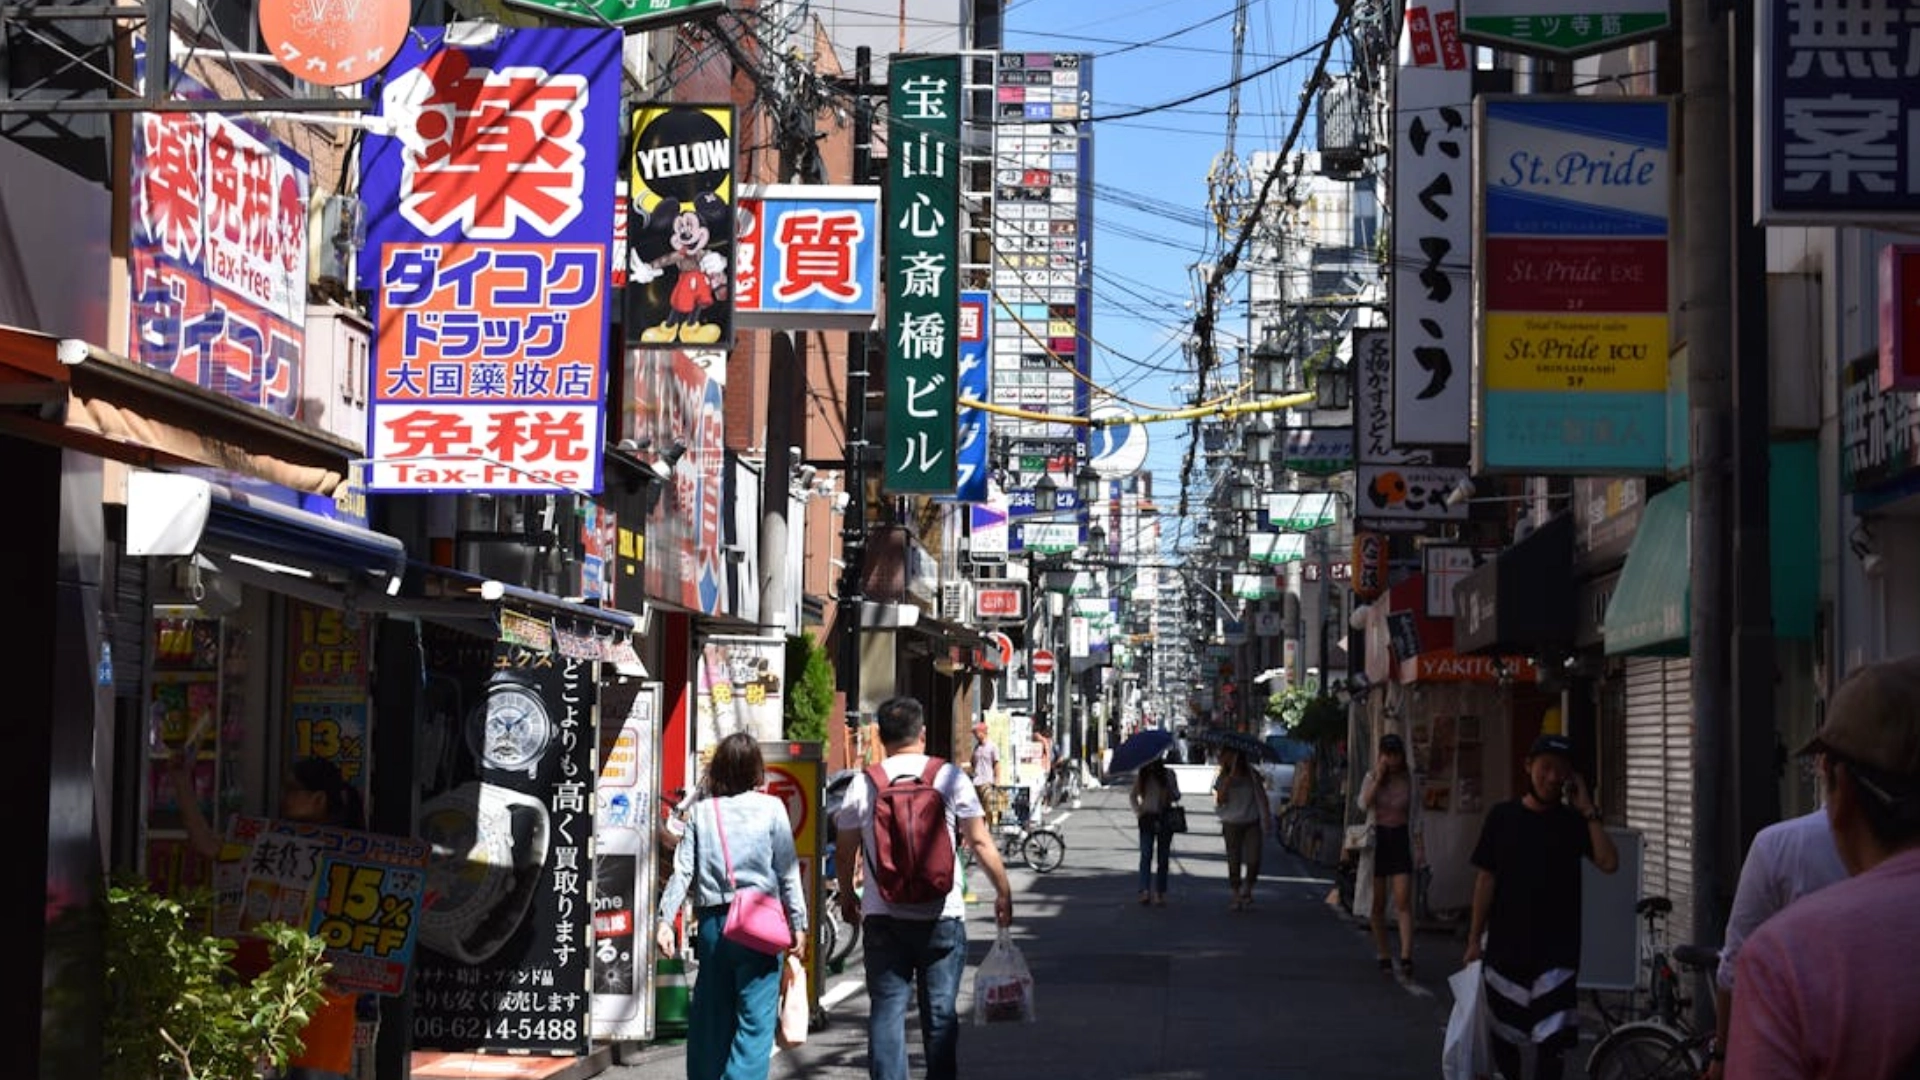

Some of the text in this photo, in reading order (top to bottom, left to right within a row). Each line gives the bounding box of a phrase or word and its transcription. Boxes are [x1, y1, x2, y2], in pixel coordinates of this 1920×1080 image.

[1511, 15, 1624, 38] 三ツ寺筋
[1786, 0, 1919, 79] 無
[402, 66, 586, 237] 薬
[638, 138, 731, 181] YELLOW
[1784, 93, 1919, 194] 案
[208, 125, 272, 262] 免税
[210, 237, 272, 303] Tax-Free
[385, 248, 600, 307] ダイコク
[776, 212, 862, 301] 質
[897, 74, 949, 475] 宝山心斎橋ビル
[138, 269, 302, 420] ダイコク
[402, 312, 568, 358] ドラッグ
[1609, 344, 1647, 361] ICU
[386, 362, 594, 397] 大国藥妝店
[383, 410, 589, 463] 免税
[390, 464, 580, 484] Tax-Free
[297, 649, 362, 674] OFF
[295, 716, 363, 760] 13%
[551, 657, 587, 967] どこよりも高く買取ります
[326, 861, 415, 929] 15%
[318, 918, 408, 957] OFF
[413, 1016, 579, 1041] 06-6214-5488
